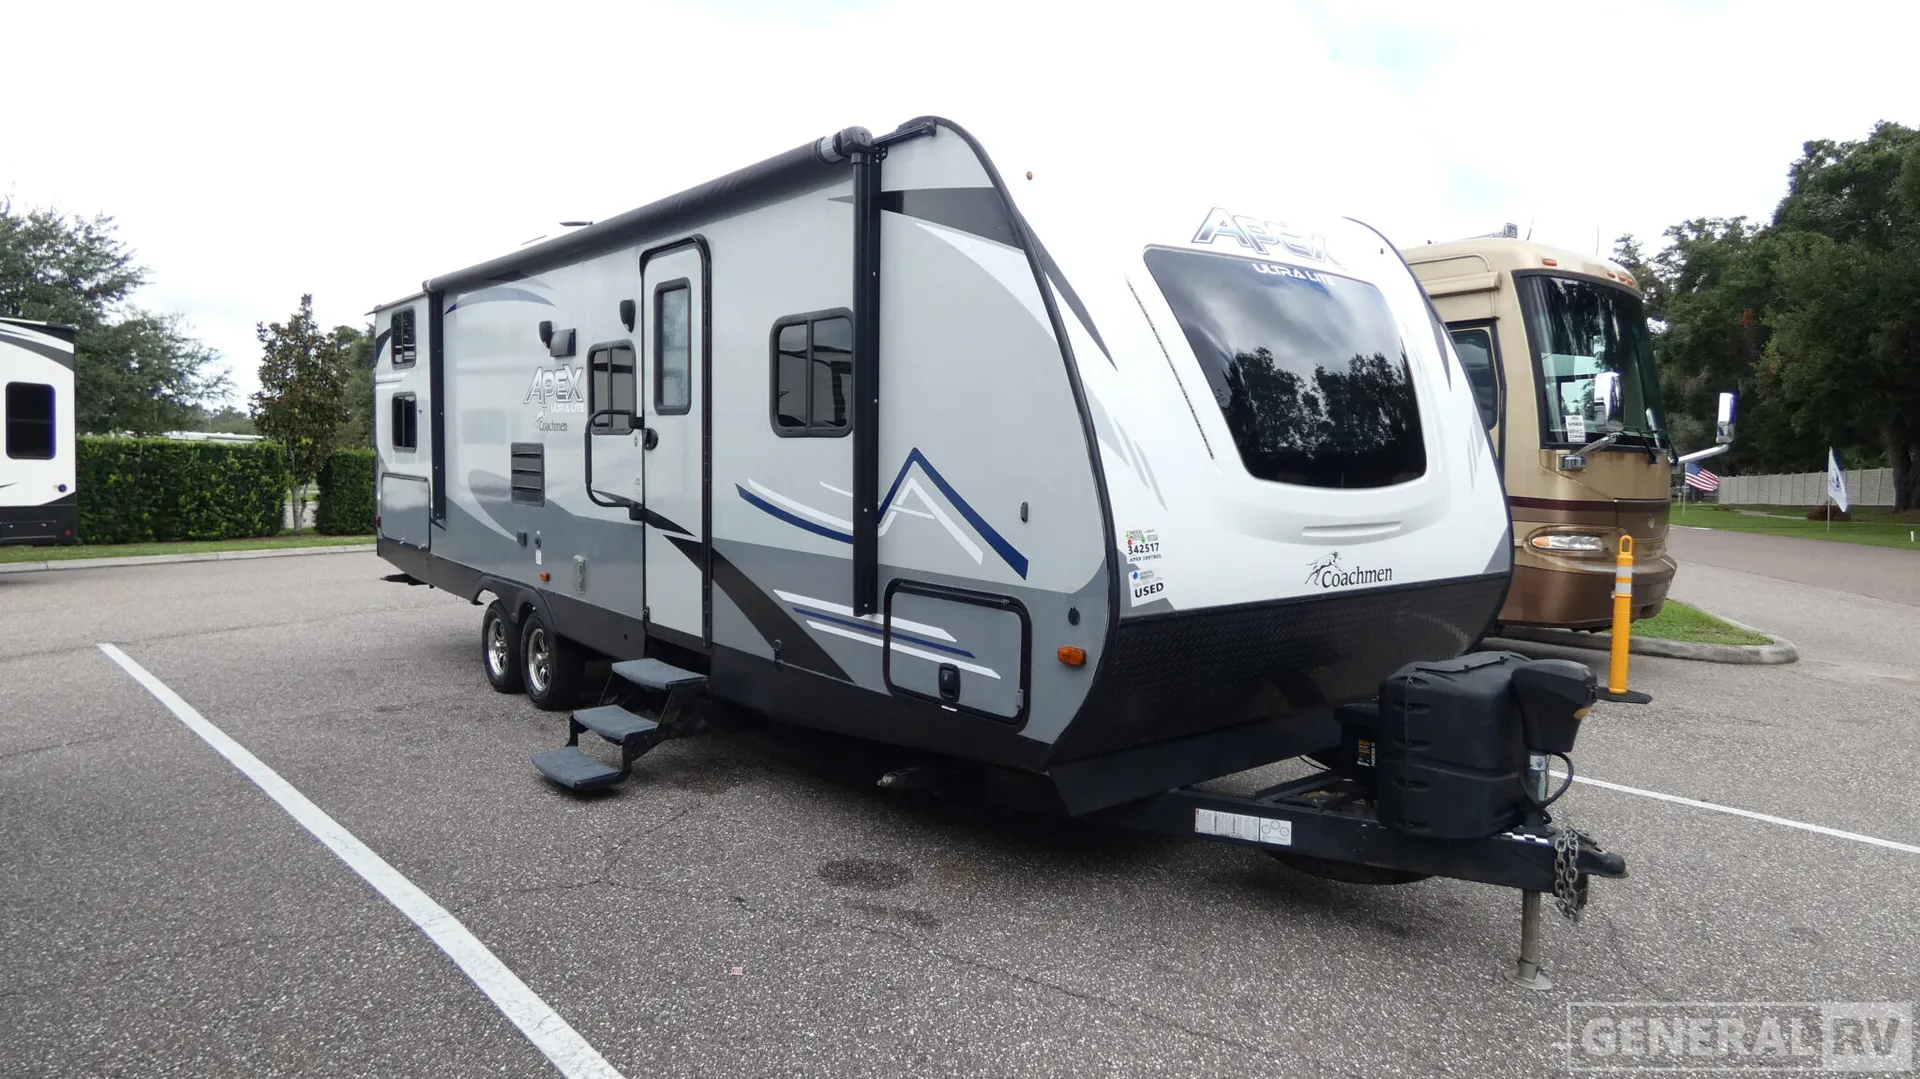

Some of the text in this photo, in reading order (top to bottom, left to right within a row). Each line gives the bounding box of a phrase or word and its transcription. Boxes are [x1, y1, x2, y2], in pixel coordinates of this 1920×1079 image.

[1191, 206, 1347, 271] APEX
[1252, 262, 1336, 287] ULTRA LITE
[523, 363, 584, 409] APEX
[538, 420, 568, 432] Coachmen
[1128, 542, 1159, 555] 342517
[1321, 566, 1392, 588] Coachmen
[1134, 582, 1164, 598] USED
